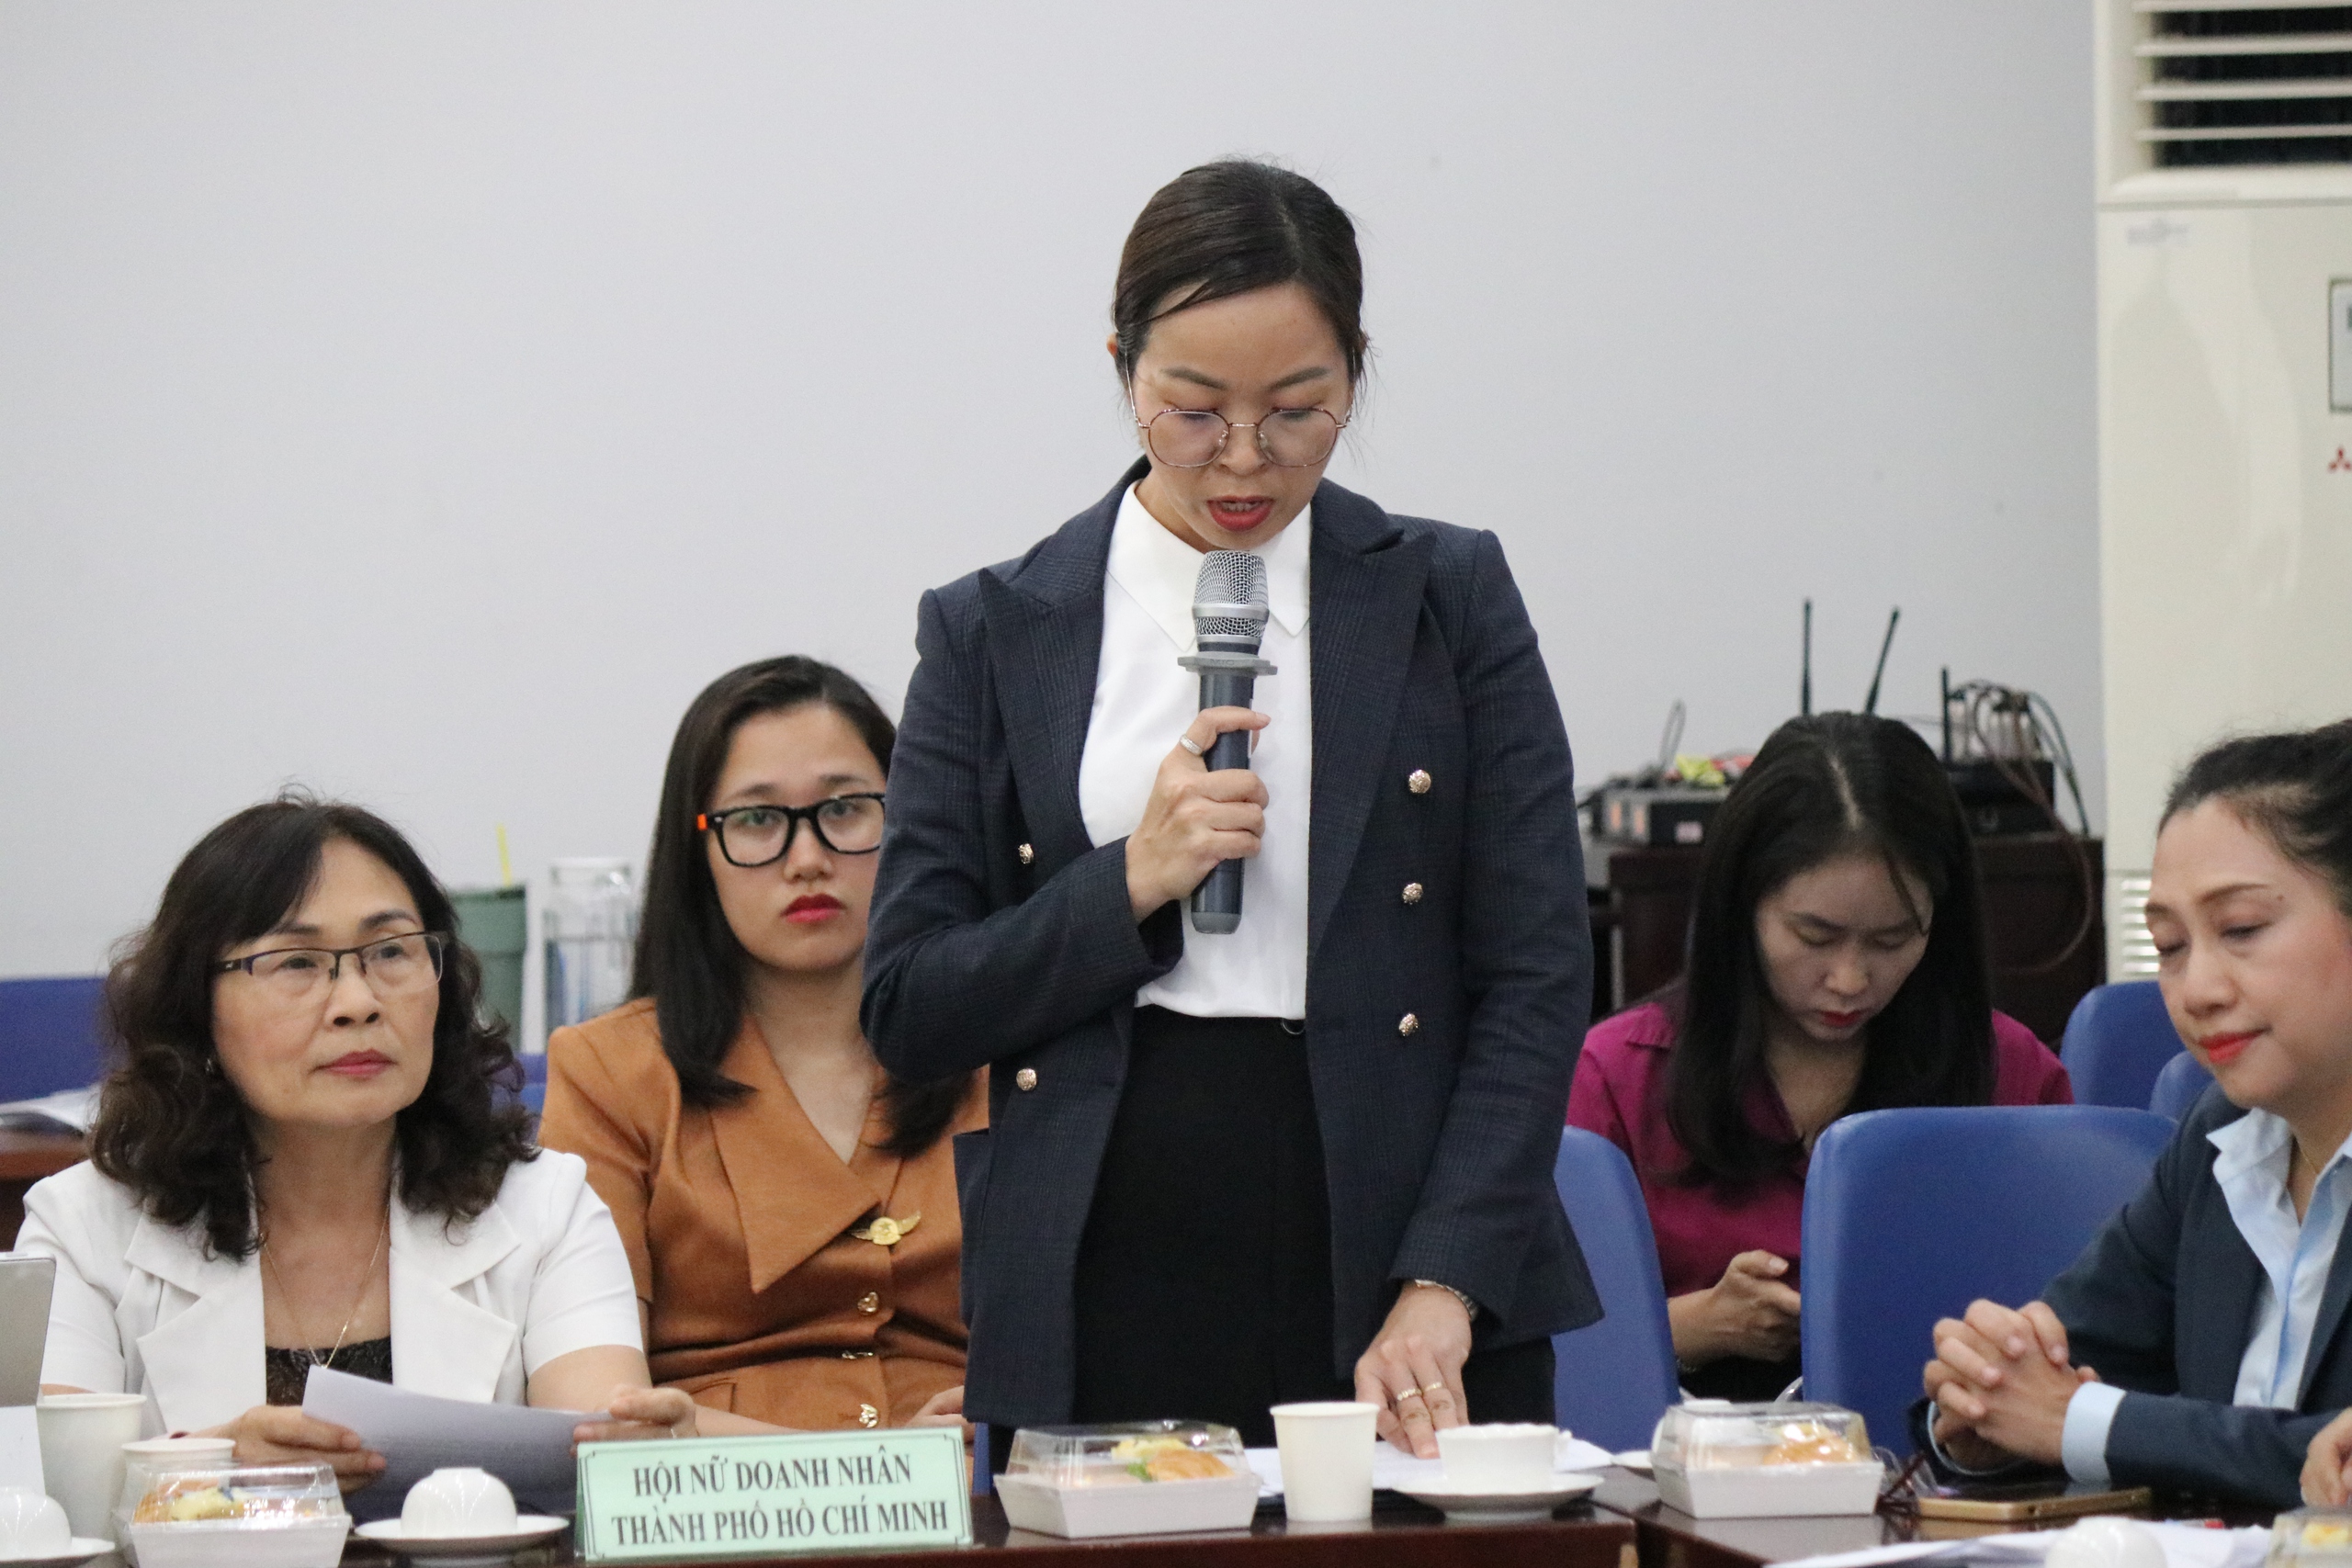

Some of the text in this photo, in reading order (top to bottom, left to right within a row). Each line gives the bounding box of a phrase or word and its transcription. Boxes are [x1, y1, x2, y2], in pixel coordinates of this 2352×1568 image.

[633, 1444, 911, 1504] HỘI NỮ DOANH NHÂN
[611, 1495, 949, 1545] THÀNH PHỐ HỒ CHÍ MINH
